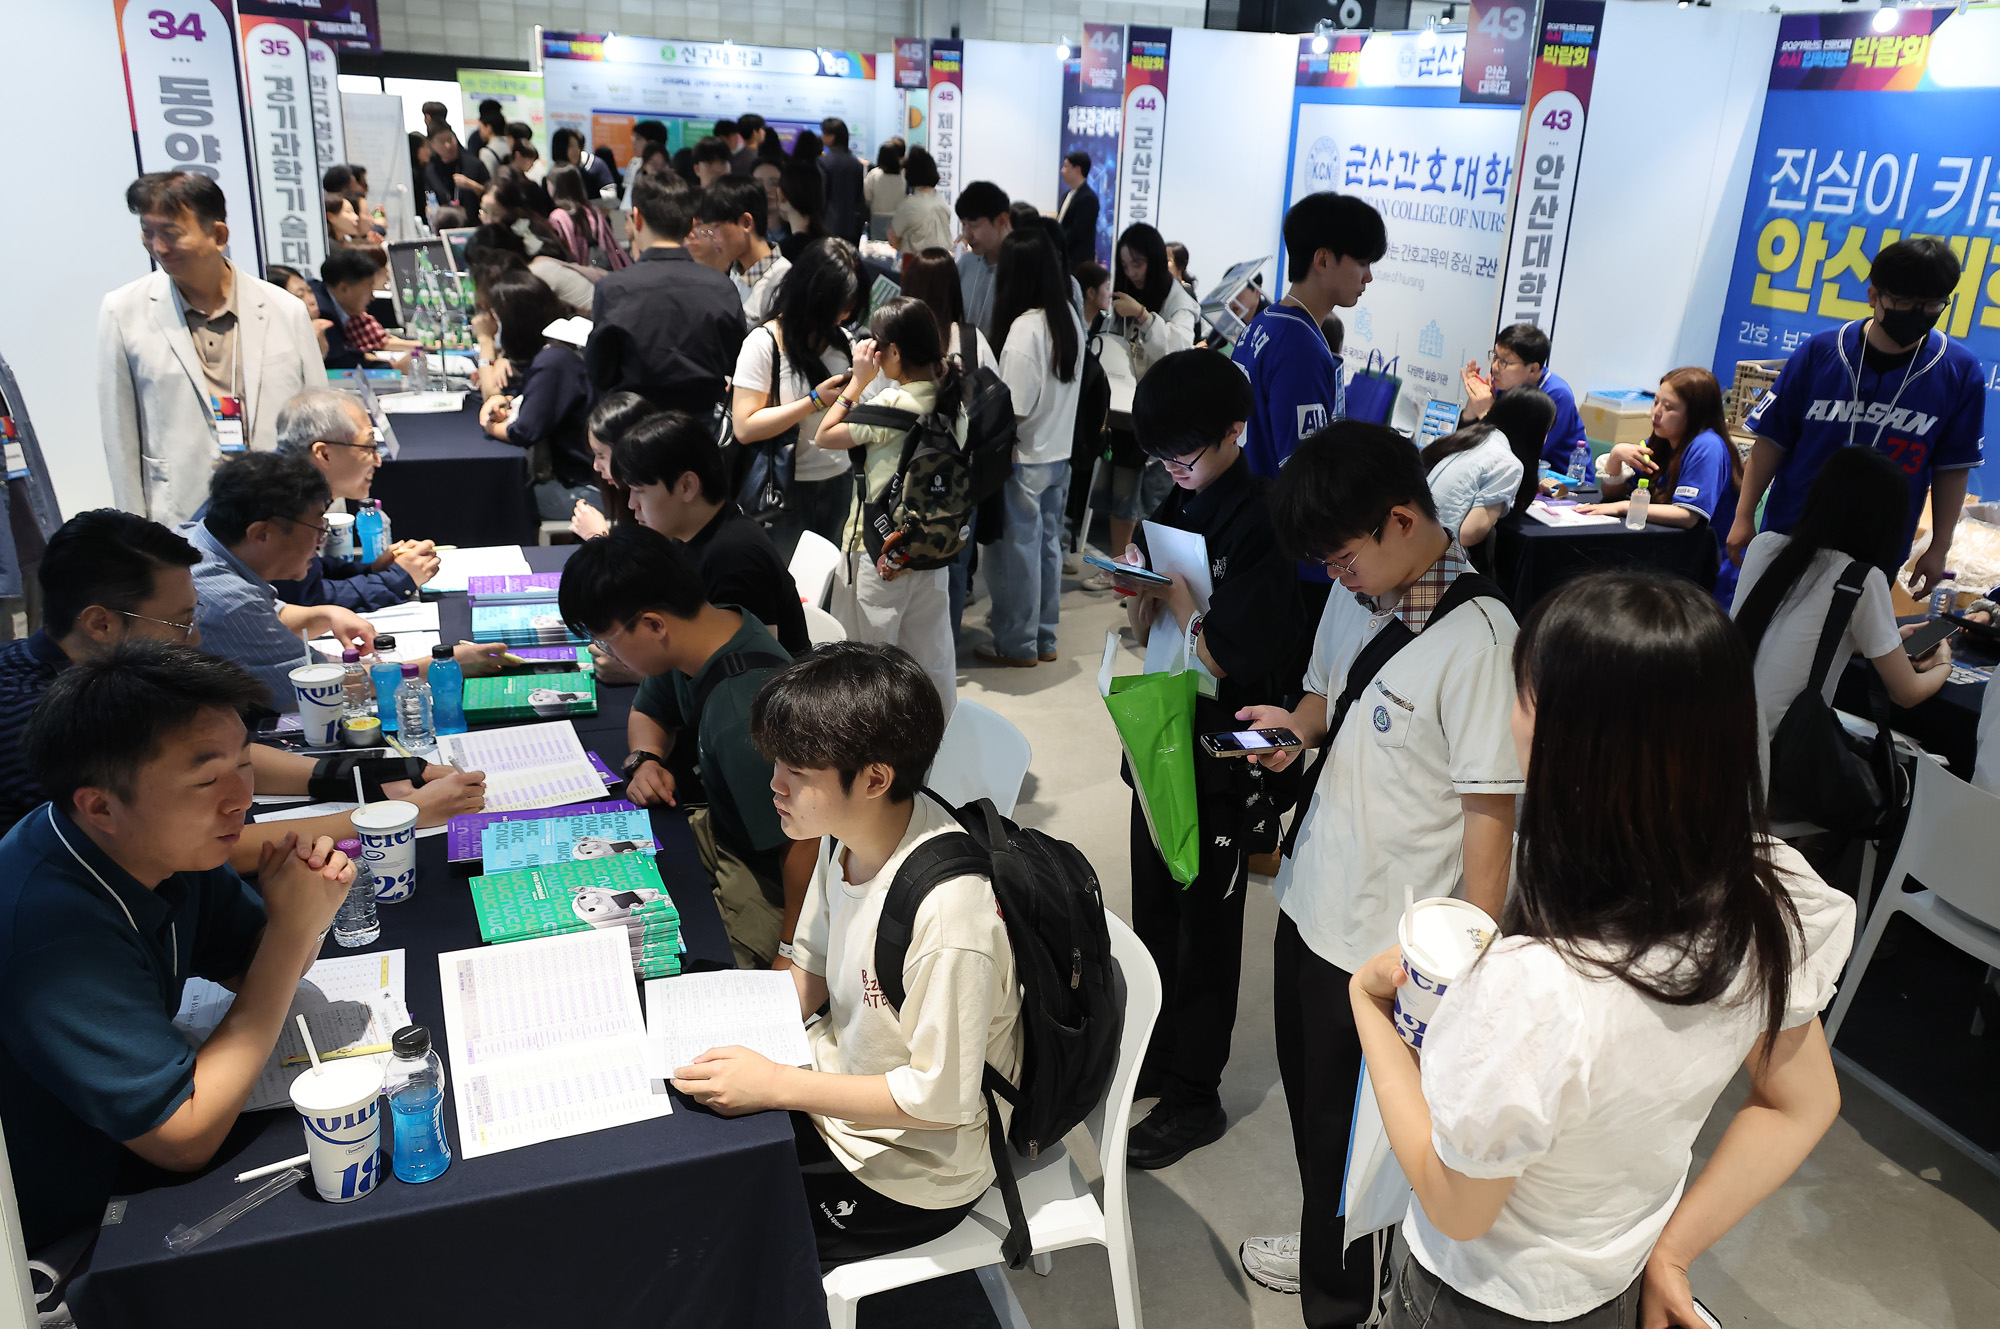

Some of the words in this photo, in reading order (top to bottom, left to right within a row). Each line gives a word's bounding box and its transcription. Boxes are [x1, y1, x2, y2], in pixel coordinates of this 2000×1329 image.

[148, 9, 207, 41] 34
[1477, 6, 1527, 40] 43
[260, 39, 291, 56] 35
[1088, 31, 1121, 53] 44
[1543, 44, 1590, 68] 박람회
[1851, 34, 1930, 69] 박람회
[1485, 65, 1507, 80] 안산
[938, 91, 954, 101] 45
[1478, 80, 1511, 95] 대학교
[1135, 96, 1157, 111] 44
[1542, 109, 1573, 131] 43
[1128, 126, 1154, 225] 군산간호
[1767, 147, 1919, 220] 진심이
[1391, 199, 1448, 225] COLLEGE
[1449, 206, 1469, 227] OF
[1401, 243, 1450, 270] 간호교육의
[1476, 256, 1499, 279] 군산
[1738, 320, 1770, 348] 간호
[1805, 399, 1939, 437] ANSAN
[1886, 437, 1928, 475] 73
[374, 867, 415, 901] 23
